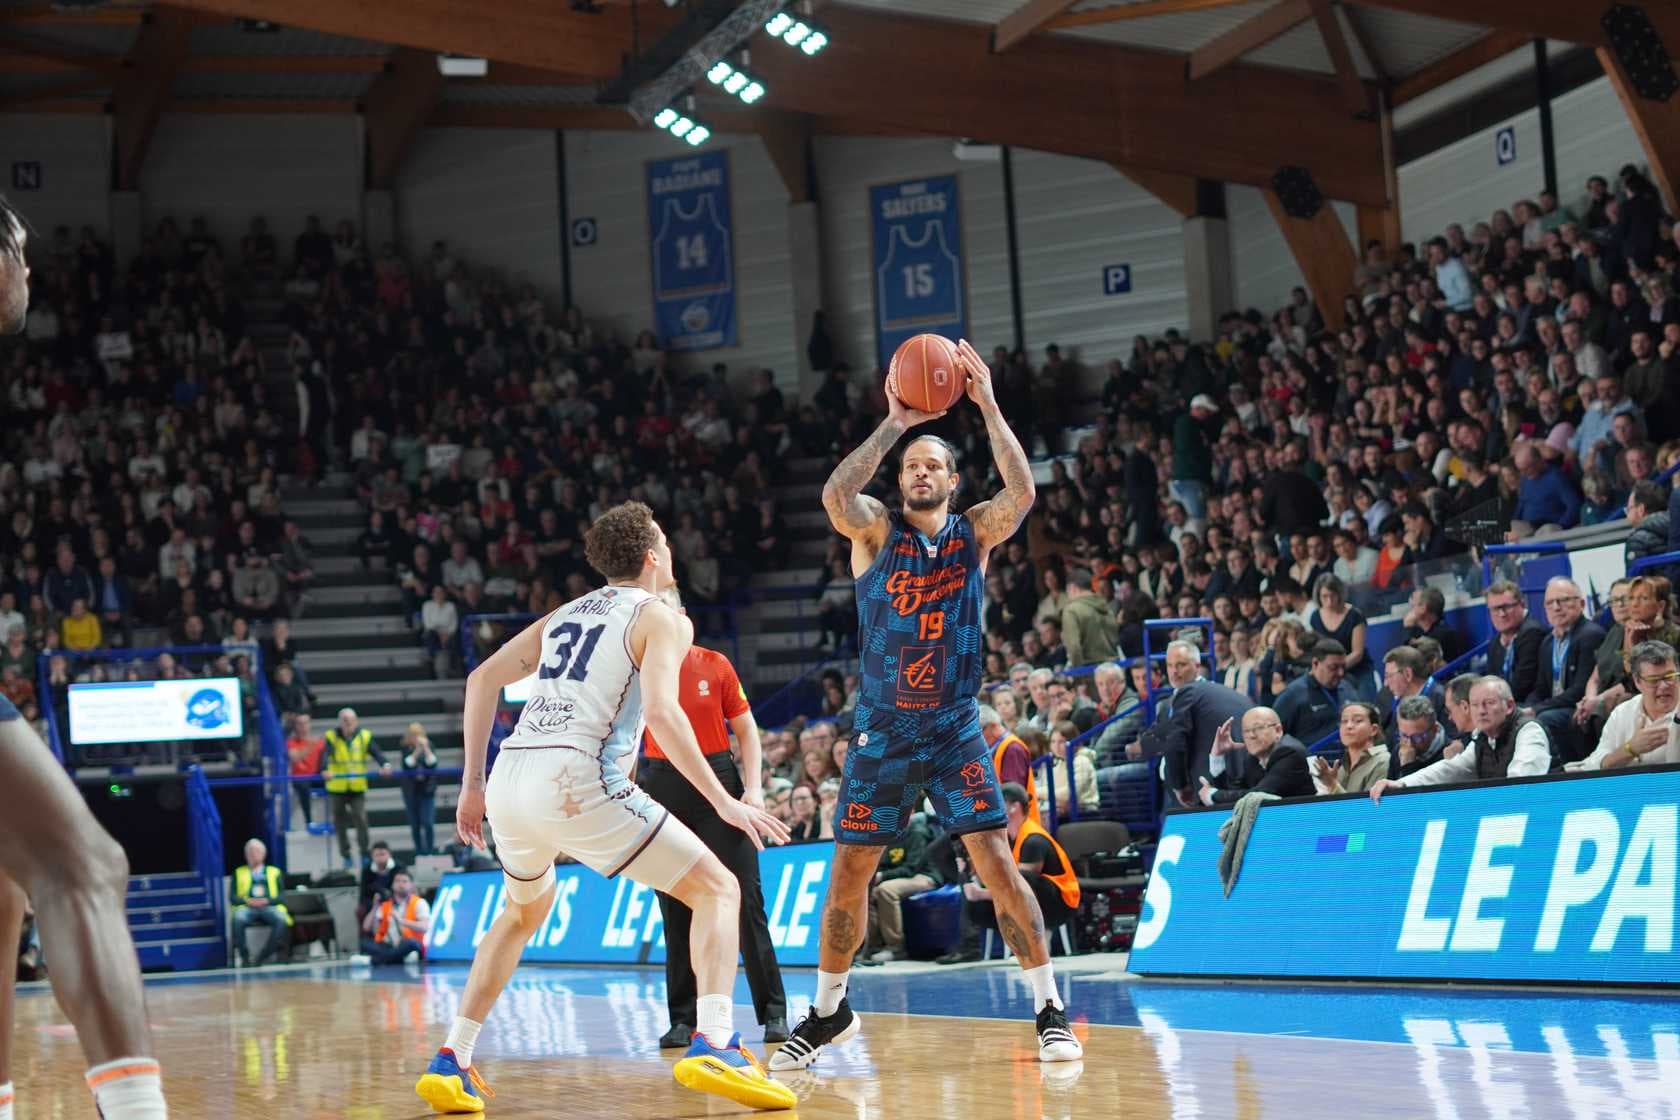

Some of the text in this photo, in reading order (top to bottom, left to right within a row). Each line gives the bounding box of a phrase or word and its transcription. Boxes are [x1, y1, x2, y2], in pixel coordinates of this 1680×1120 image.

[1498, 131, 1513, 160] Q
[18, 167, 36, 187] N
[575, 220, 594, 243] O
[676, 234, 709, 269] 14
[903, 262, 935, 298] 15
[1108, 268, 1126, 291] P
[918, 611, 945, 640] 19
[539, 622, 607, 682] 31
[523, 696, 575, 720] Pierre
[539, 713, 576, 728] Clot
[840, 819, 878, 831] Clovis
[1397, 813, 1529, 951] LE
[1533, 803, 1679, 952] PA
[601, 876, 649, 947] LE
[767, 861, 826, 947] LE
